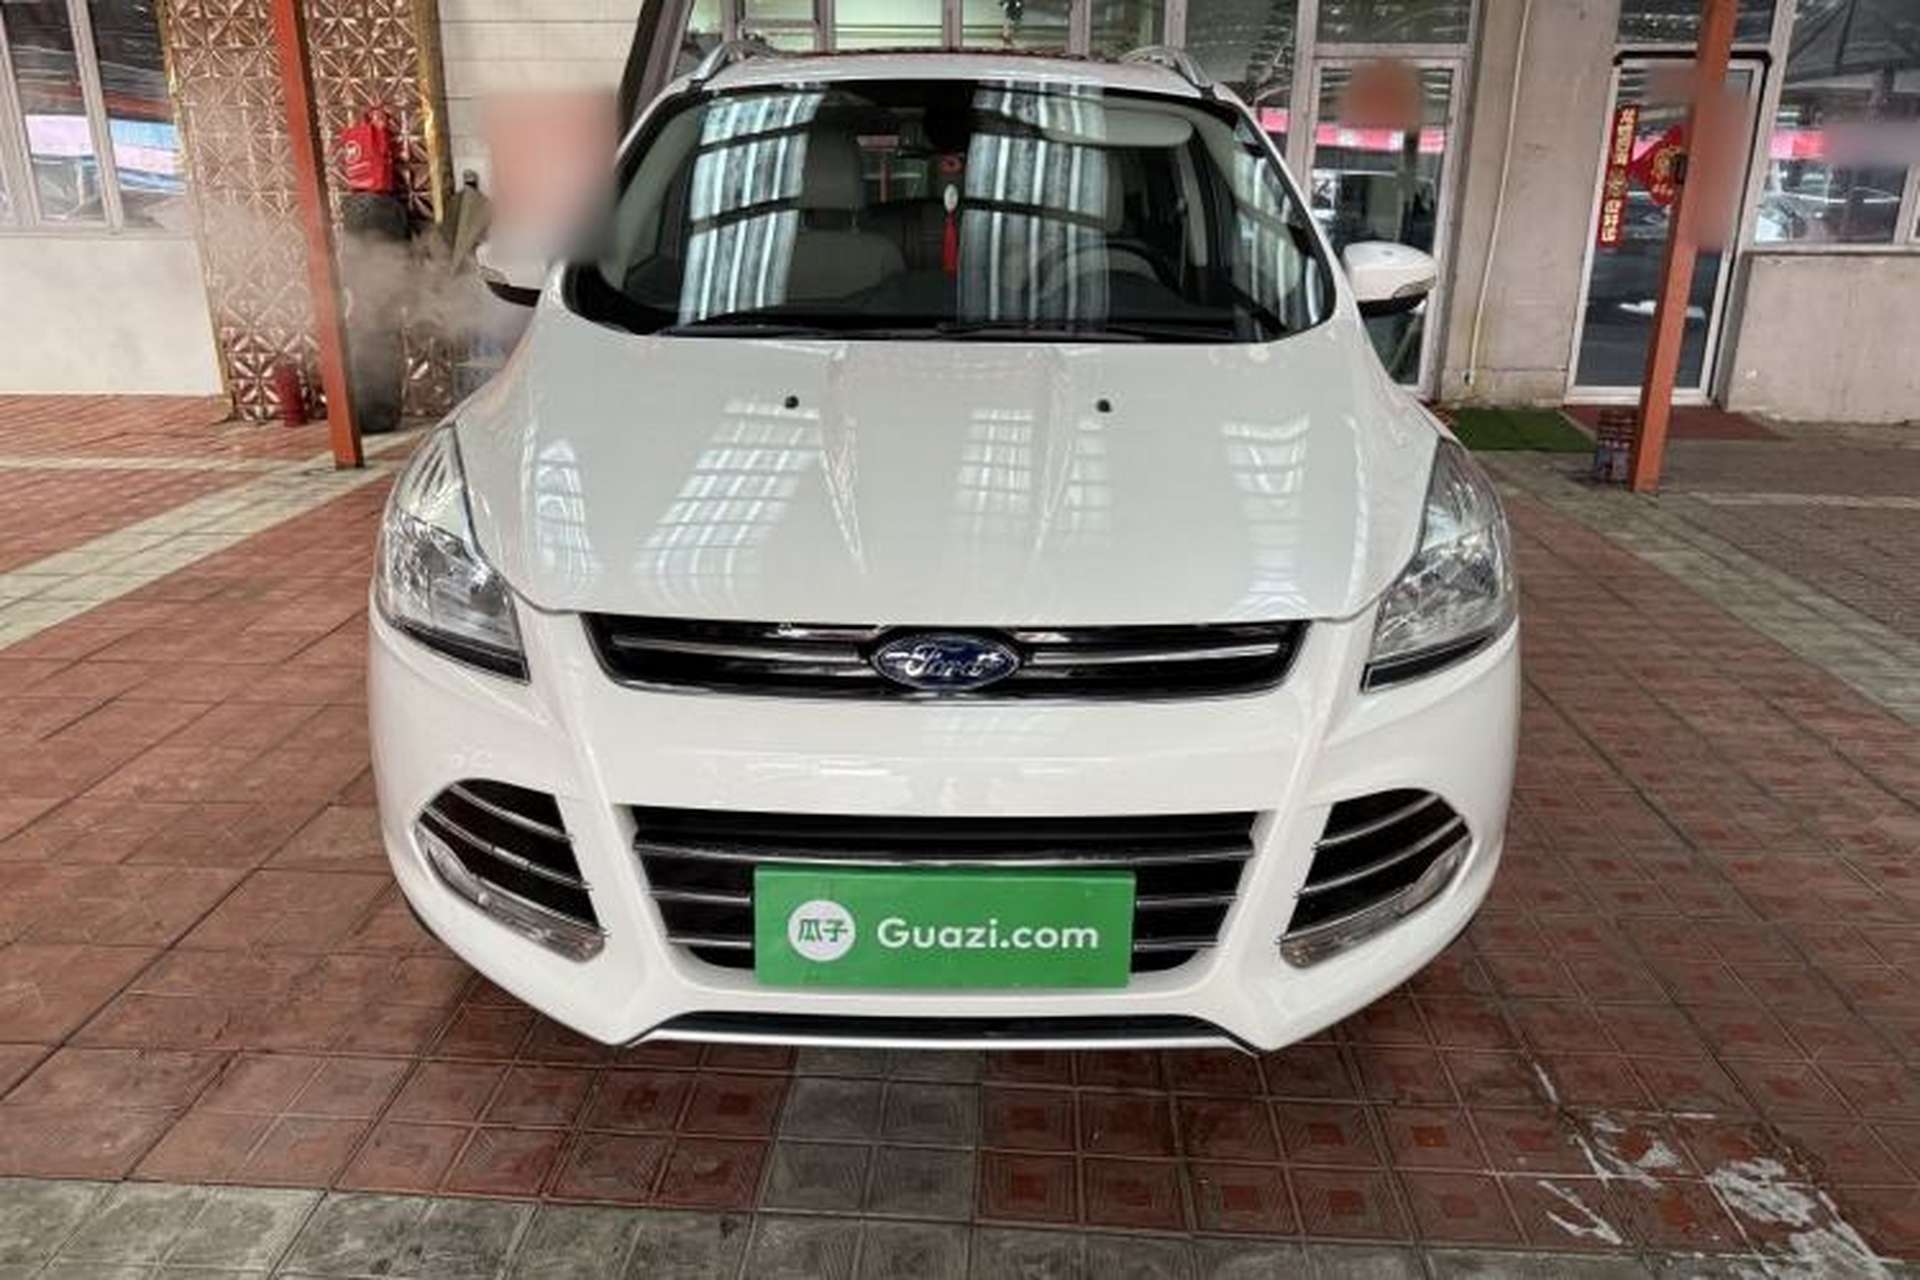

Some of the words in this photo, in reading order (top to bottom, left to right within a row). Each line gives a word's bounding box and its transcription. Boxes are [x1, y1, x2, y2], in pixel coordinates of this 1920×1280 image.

[886, 644, 1003, 677] Ford
[798, 919, 848, 942] 瓜子
[877, 917, 1098, 949] Guazi.com
